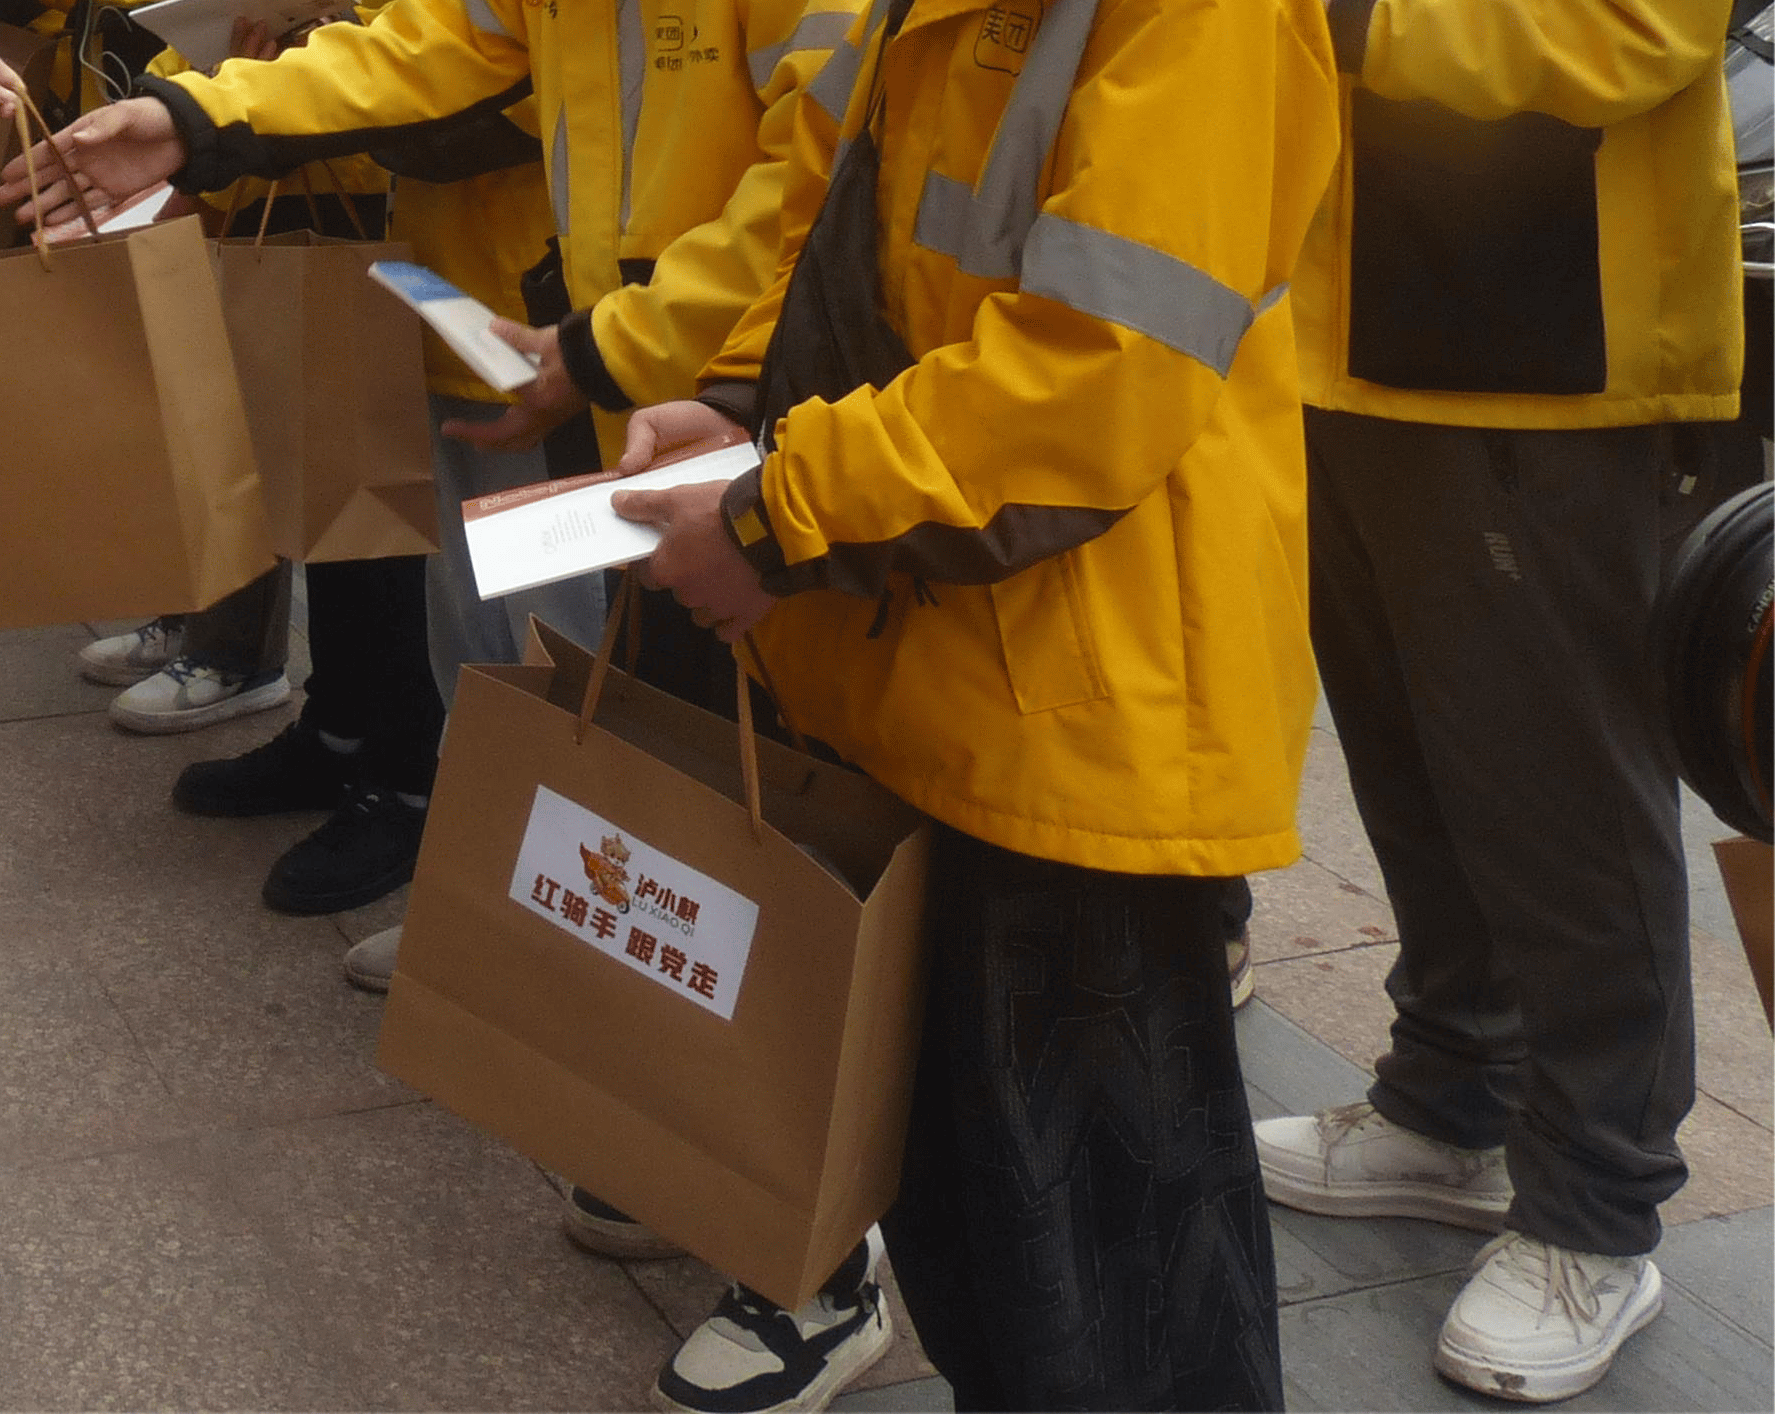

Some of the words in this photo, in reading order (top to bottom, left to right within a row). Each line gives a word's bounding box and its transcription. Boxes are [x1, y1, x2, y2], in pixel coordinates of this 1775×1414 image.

[982, 8, 1034, 54] 美团
[632, 896, 648, 911] LU
[649, 905, 679, 928] XIAO
[681, 923, 695, 937] QI
[635, 873, 700, 925] 泸小麒
[530, 873, 618, 939] 红骑手
[625, 925, 719, 1000] 跟党走
